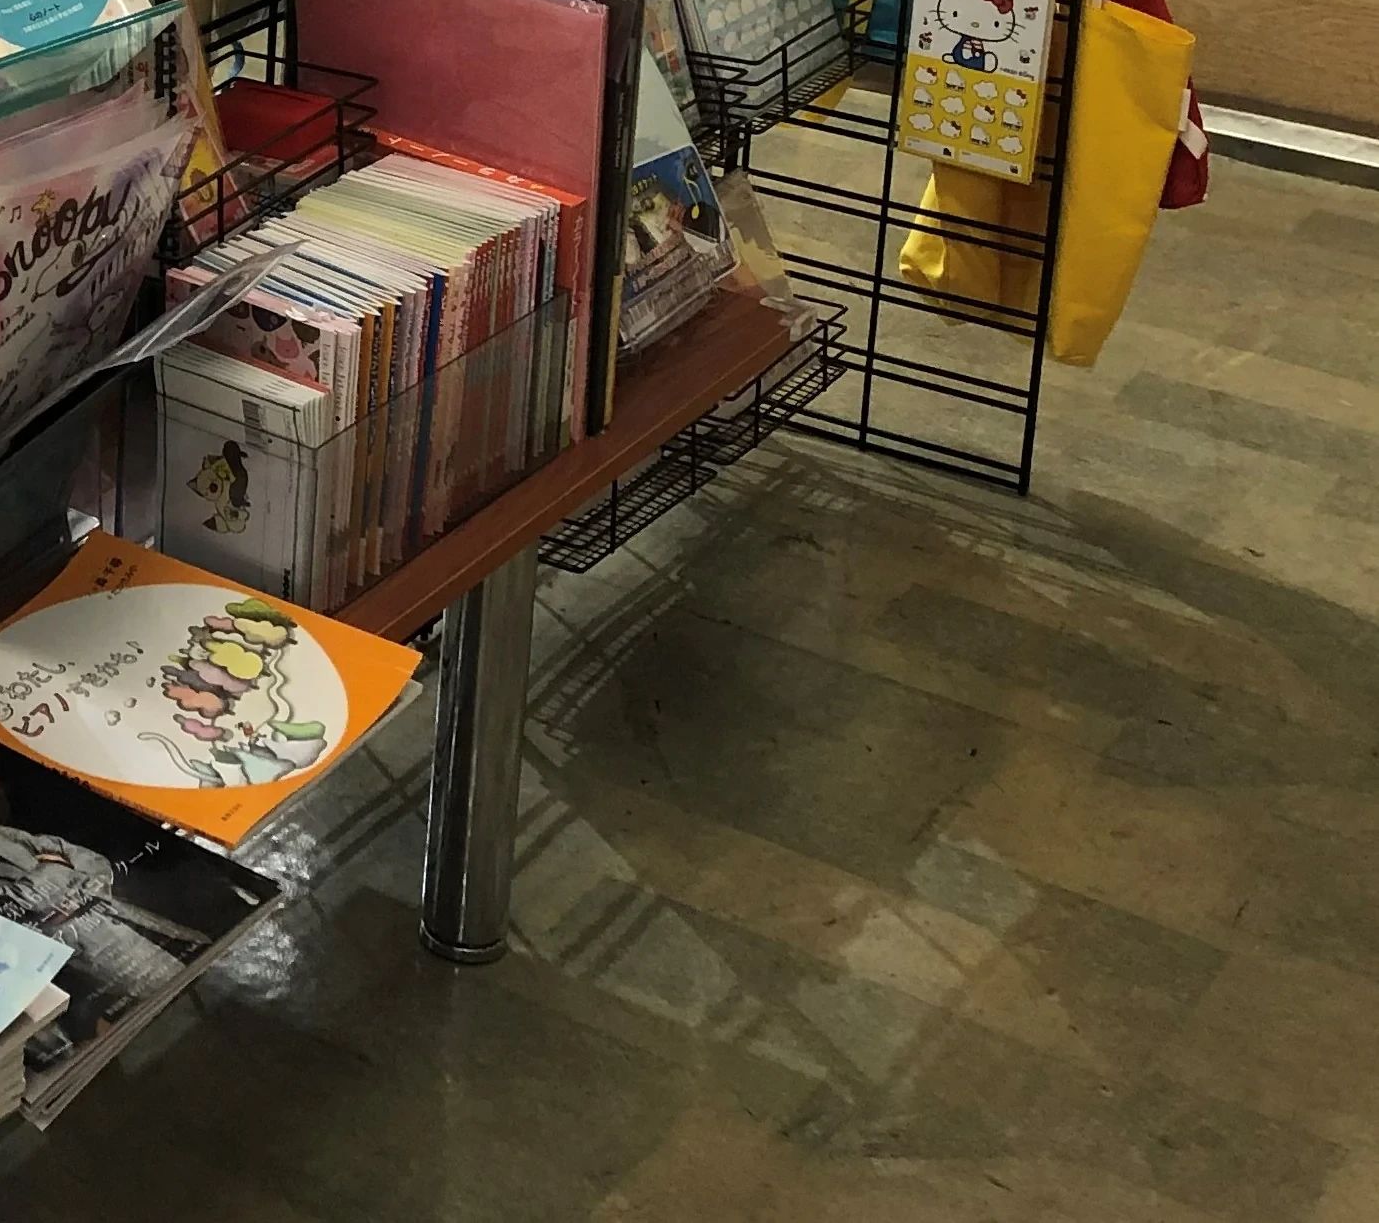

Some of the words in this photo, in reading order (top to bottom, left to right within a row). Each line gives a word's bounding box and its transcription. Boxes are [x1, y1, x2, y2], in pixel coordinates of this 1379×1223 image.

[29, 4, 61, 22] 心のノート
[11, 692, 71, 738] ピアノ
